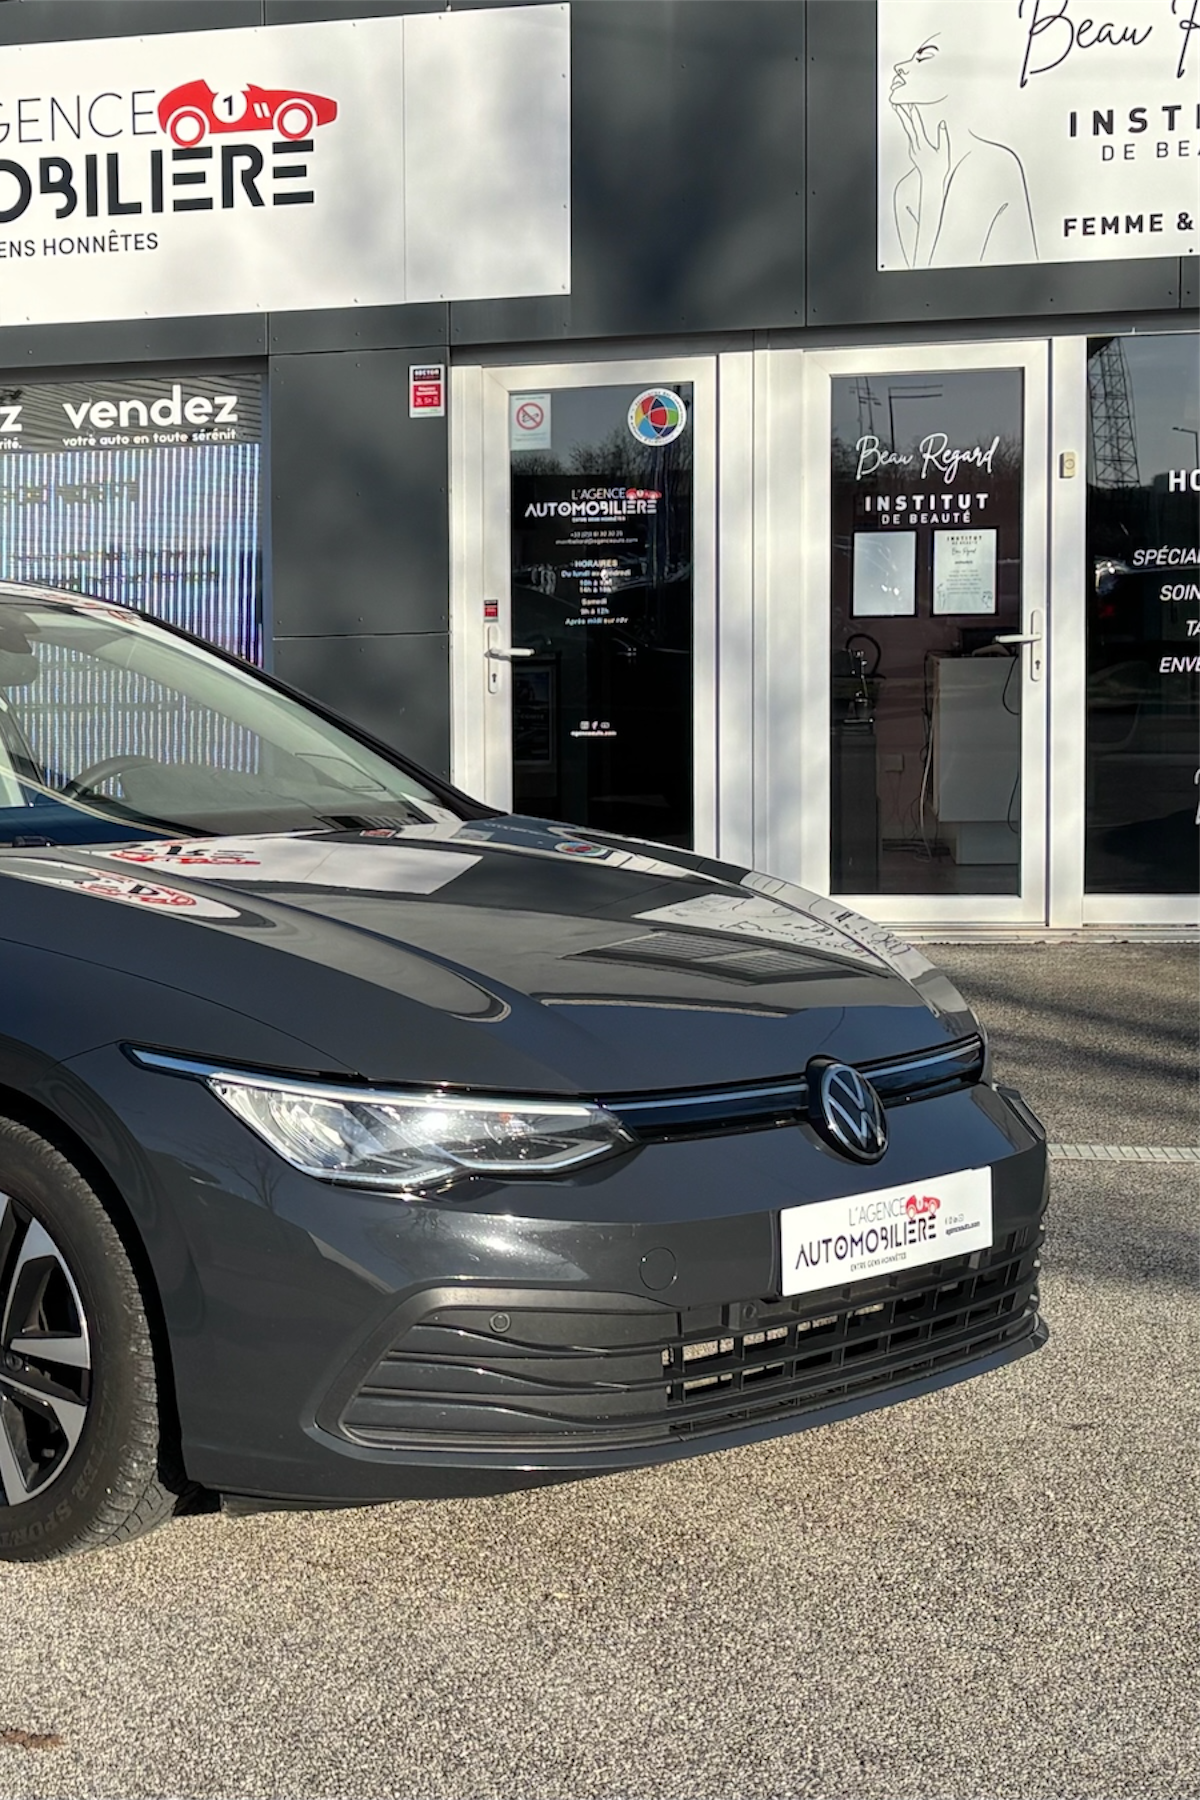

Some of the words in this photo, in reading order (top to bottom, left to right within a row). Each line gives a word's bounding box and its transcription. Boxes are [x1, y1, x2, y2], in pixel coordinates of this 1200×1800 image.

[1102, 143, 1136, 162] DE
[1156, 139, 1200, 159] BE
[1063, 212, 1164, 238] FEMME
[1176, 211, 1195, 232] &
[42, 230, 159, 257] HONNÊTES
[62, 384, 239, 430] vendez
[62, 434, 97, 447] votre
[100, 433, 131, 446] auto
[132, 433, 150, 444] en
[152, 431, 189, 444] toute
[855, 434, 914, 481] Beau
[918, 432, 1001, 485] Regard
[571, 487, 627, 501] L'AGENCE
[865, 493, 989, 512] INSTITUT
[881, 513, 901, 525] DE
[909, 510, 971, 525] BEAUTÉ
[574, 559, 618, 568] HORAIRES
[848, 1197, 906, 1226] L'AGENCE
